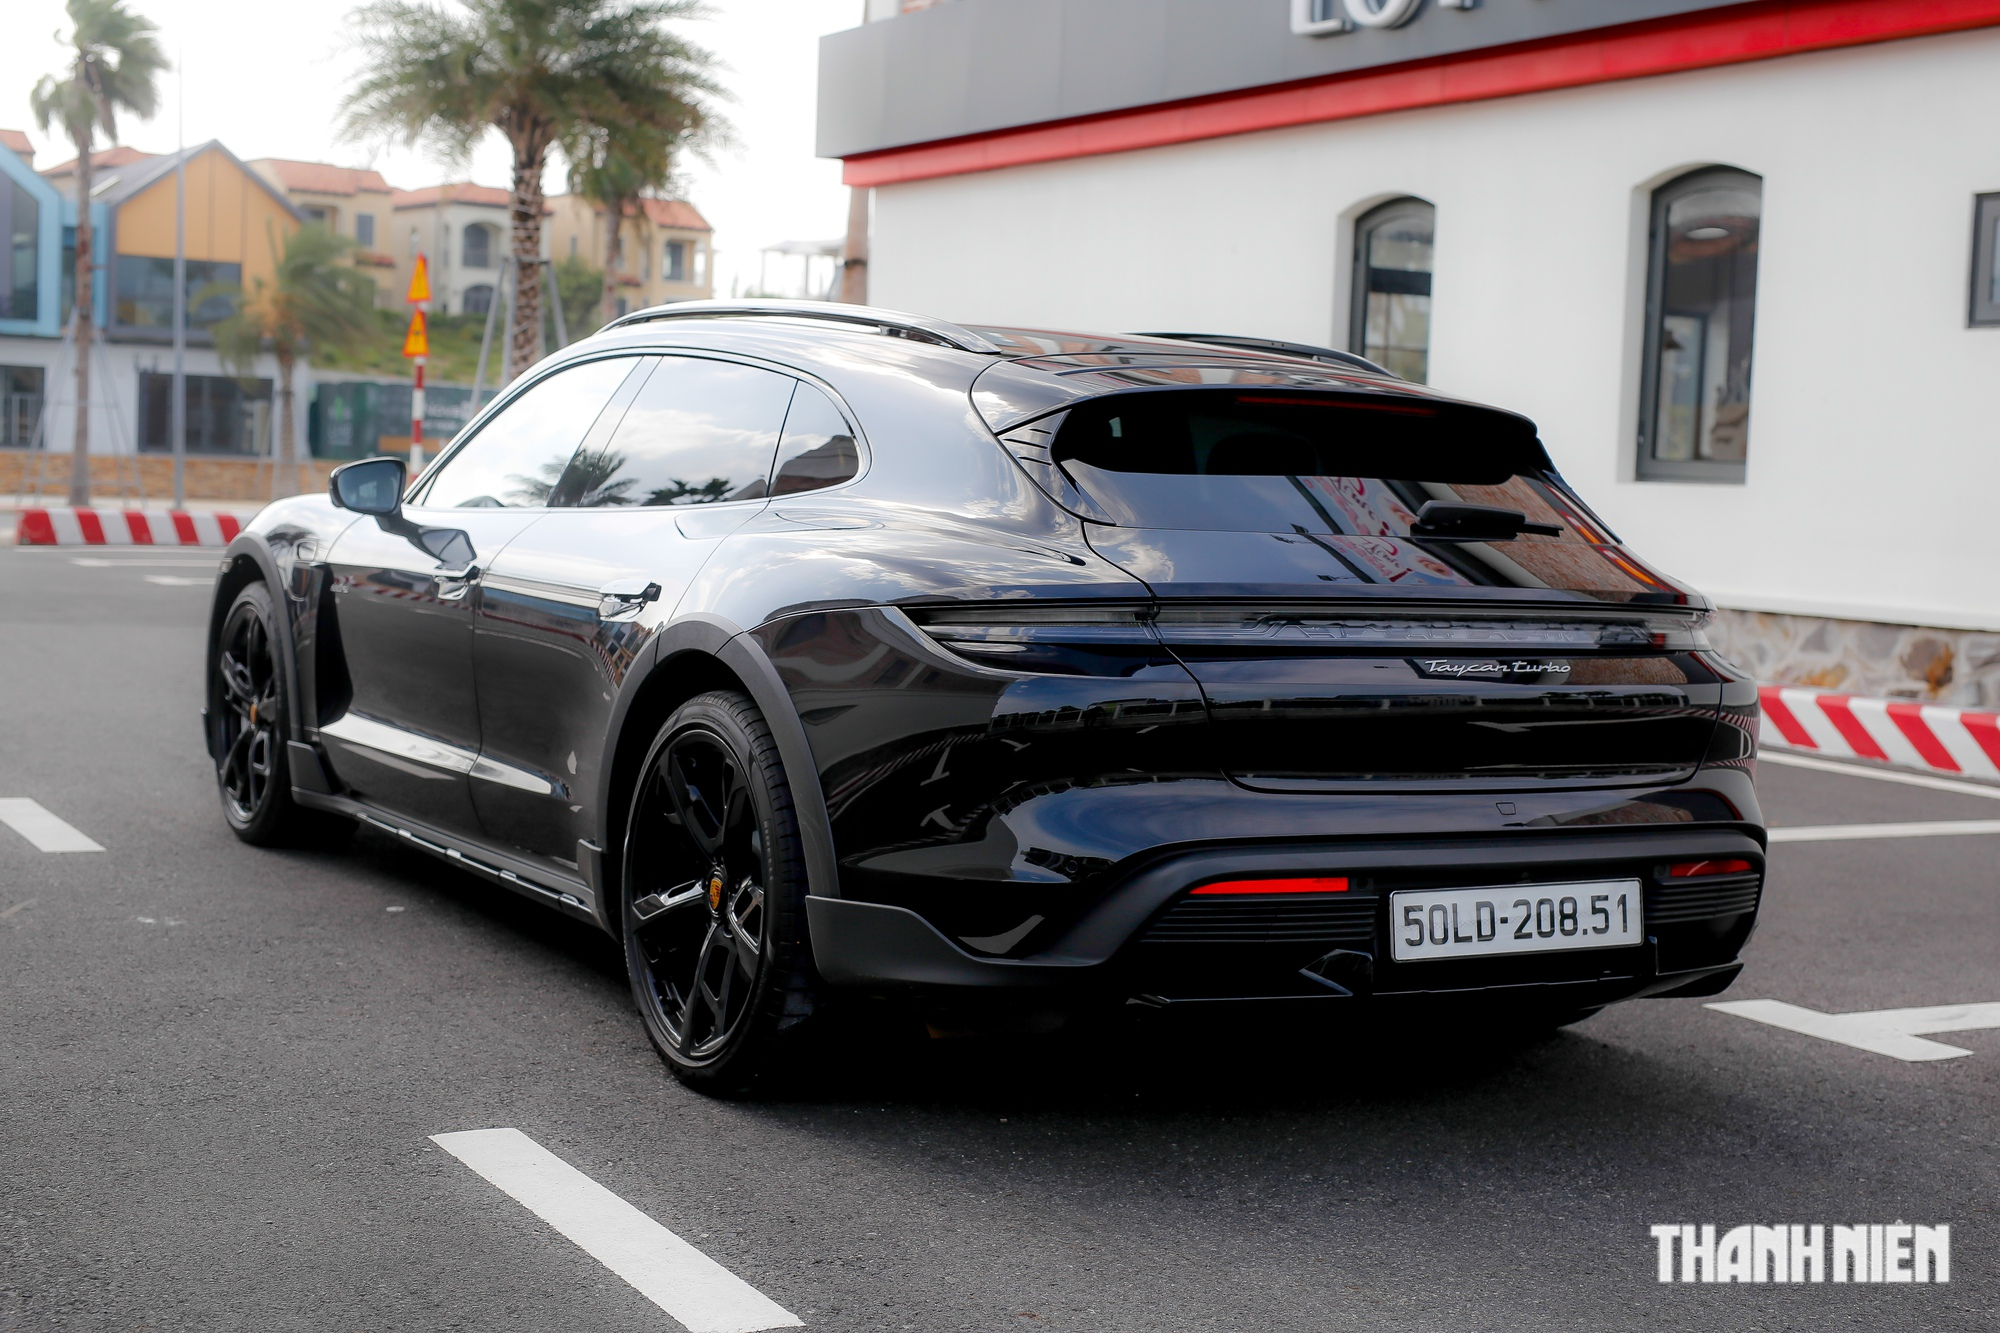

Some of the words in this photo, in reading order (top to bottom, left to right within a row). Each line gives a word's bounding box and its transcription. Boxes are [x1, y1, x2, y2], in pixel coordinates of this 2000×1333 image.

[1425, 659, 1511, 676] Taycan
[1512, 661, 1571, 673] turbo
[1403, 893, 1628, 946] 50LD-208.51
